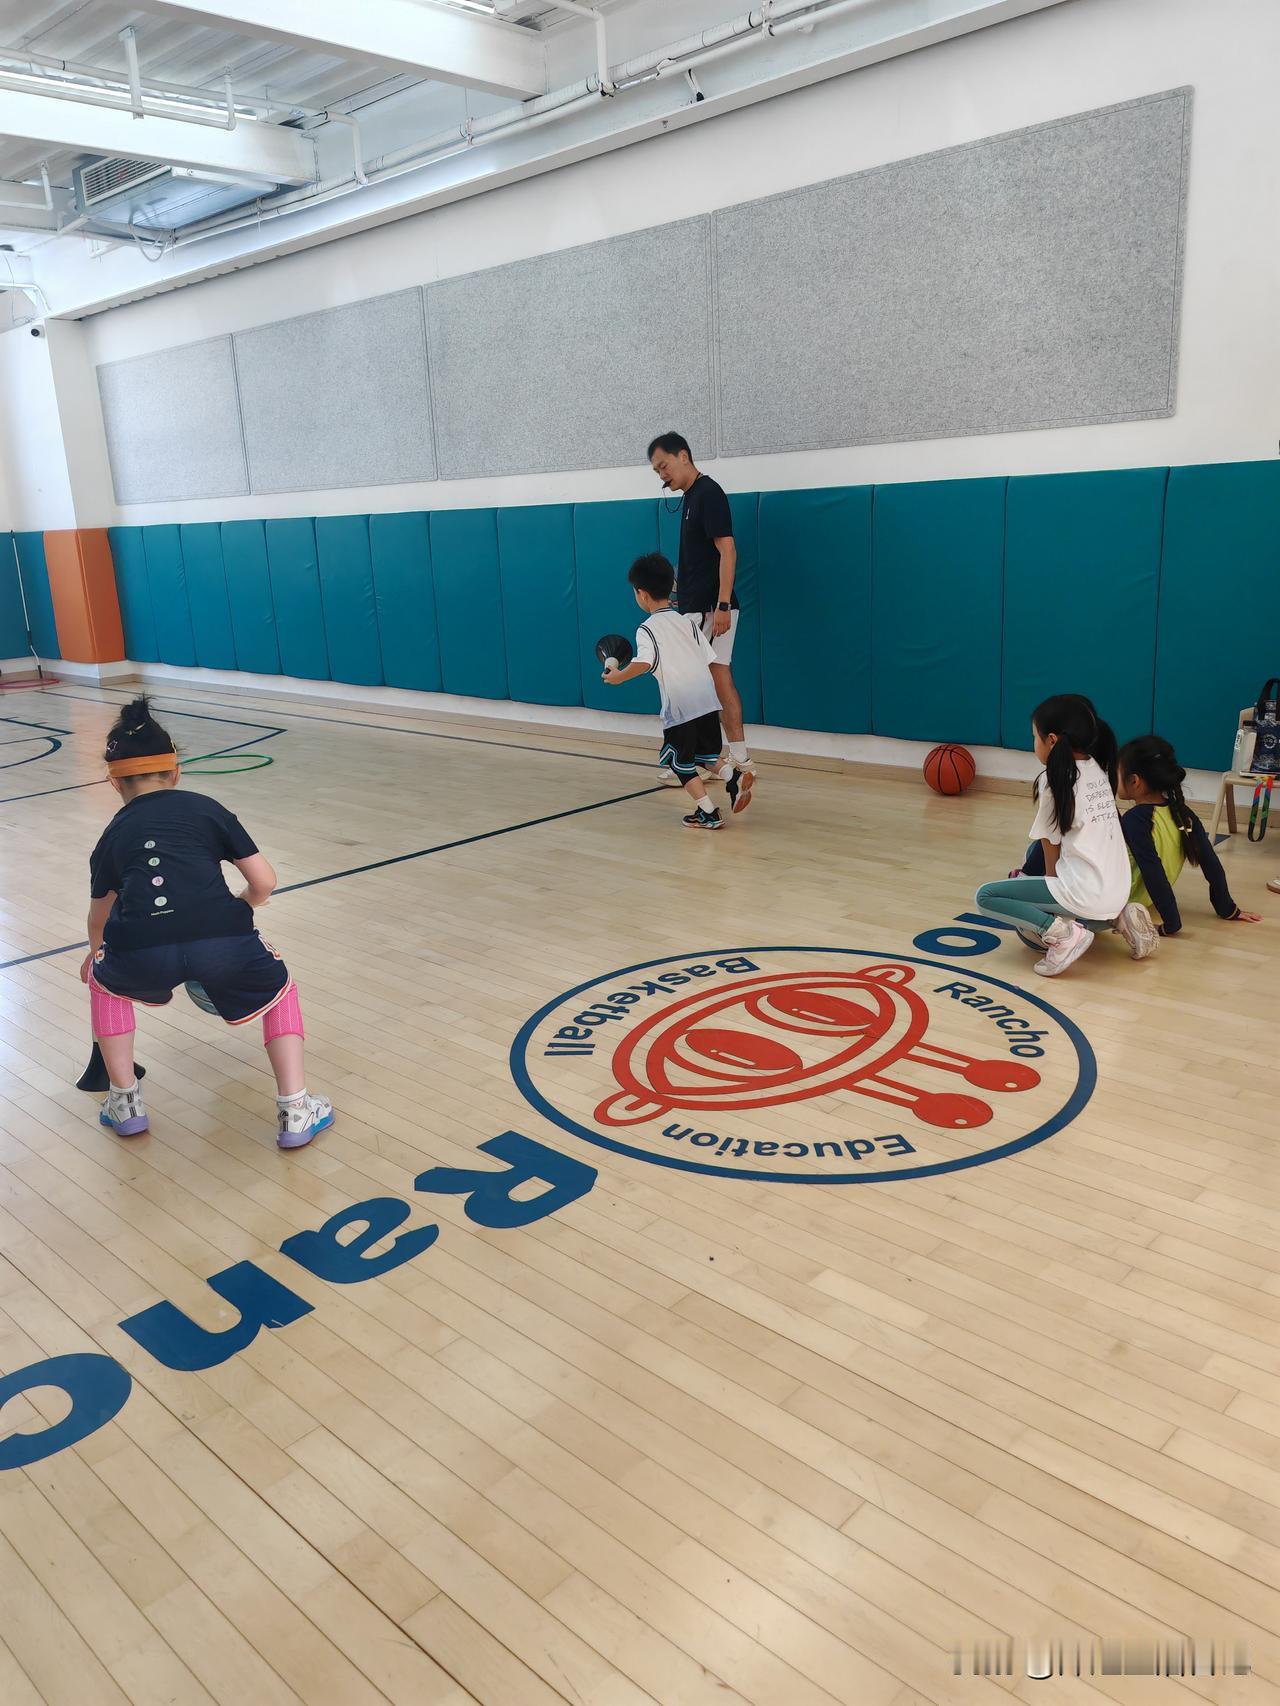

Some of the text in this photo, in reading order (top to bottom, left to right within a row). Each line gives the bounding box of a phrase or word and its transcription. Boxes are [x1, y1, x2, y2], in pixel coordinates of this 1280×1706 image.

[543, 956, 761, 1057] Basketball
[933, 980, 1046, 1059] Rancho
[661, 1123, 917, 1161] Education
